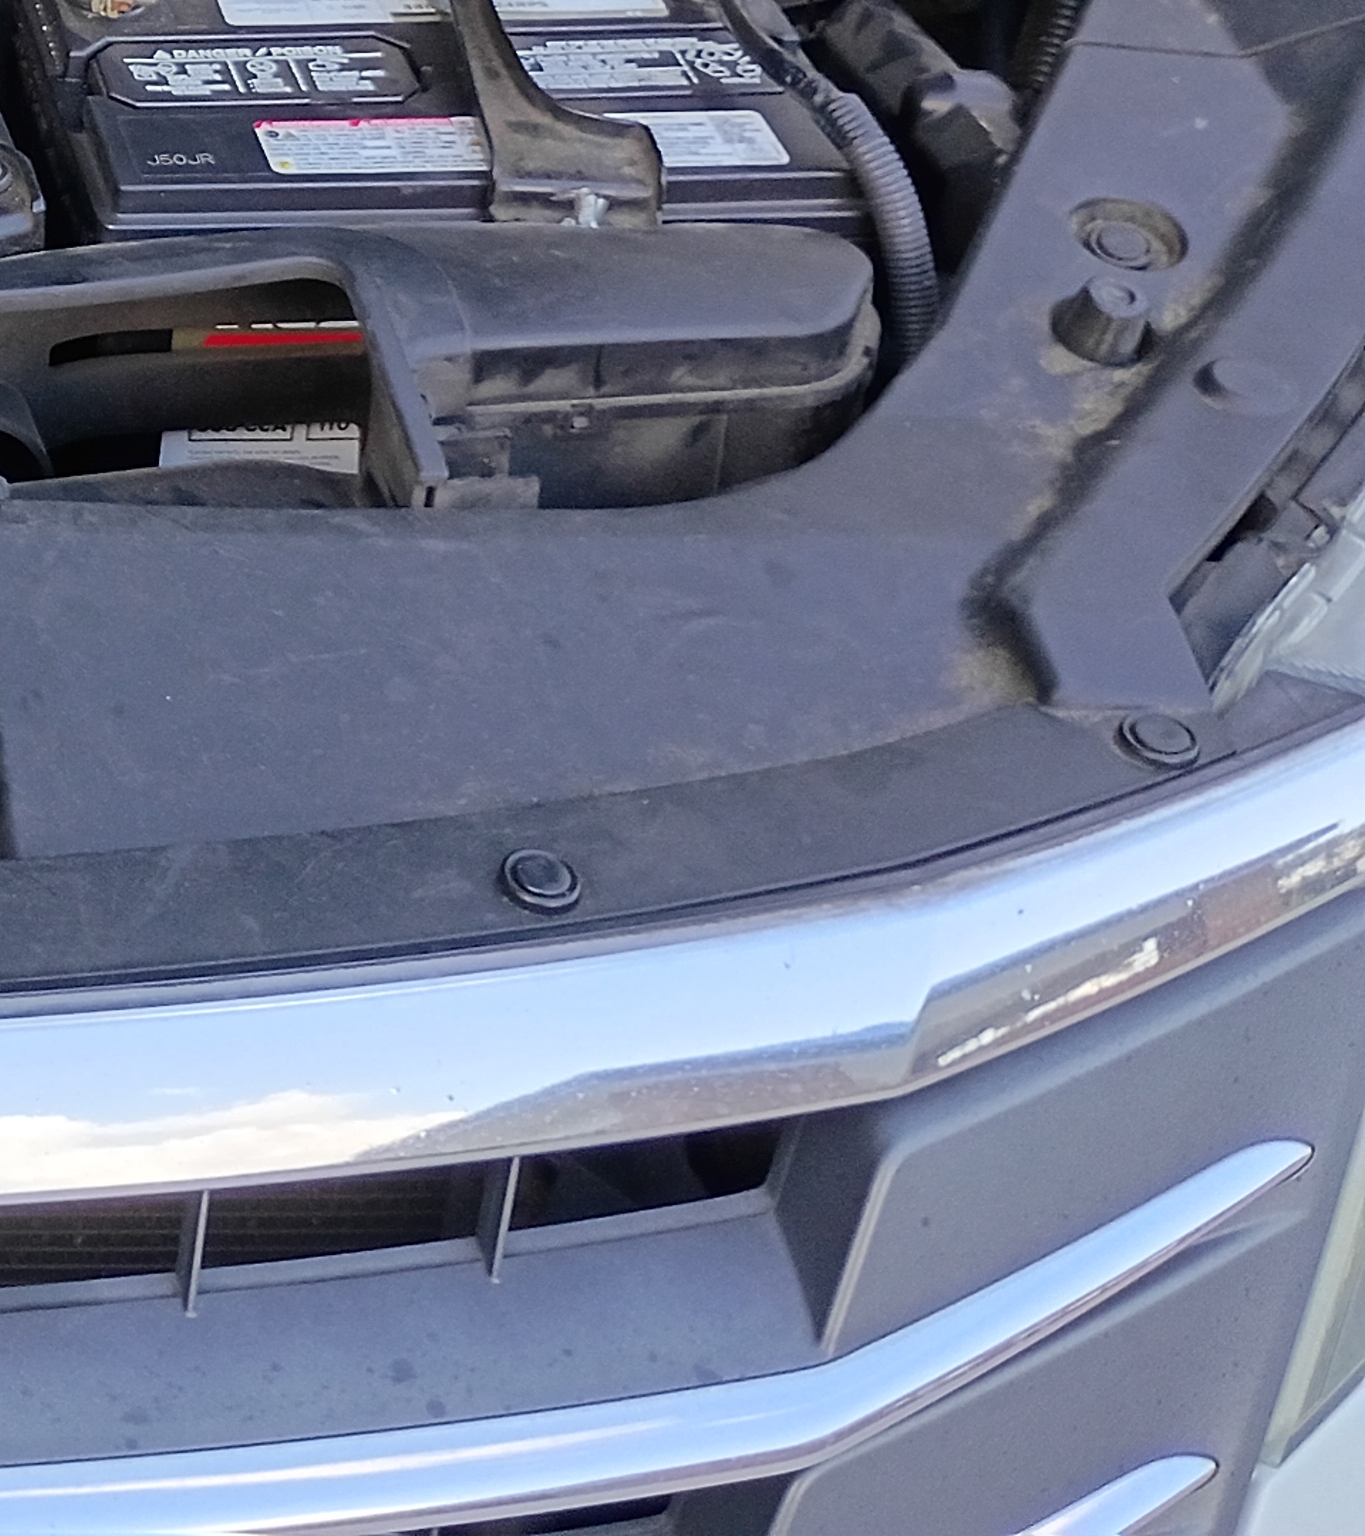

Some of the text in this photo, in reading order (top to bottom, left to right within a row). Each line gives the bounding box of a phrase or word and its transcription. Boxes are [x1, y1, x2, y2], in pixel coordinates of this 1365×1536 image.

[173, 48, 252, 60] DANGER
[270, 45, 344, 57] POISON
[146, 153, 216, 167] J50JR
